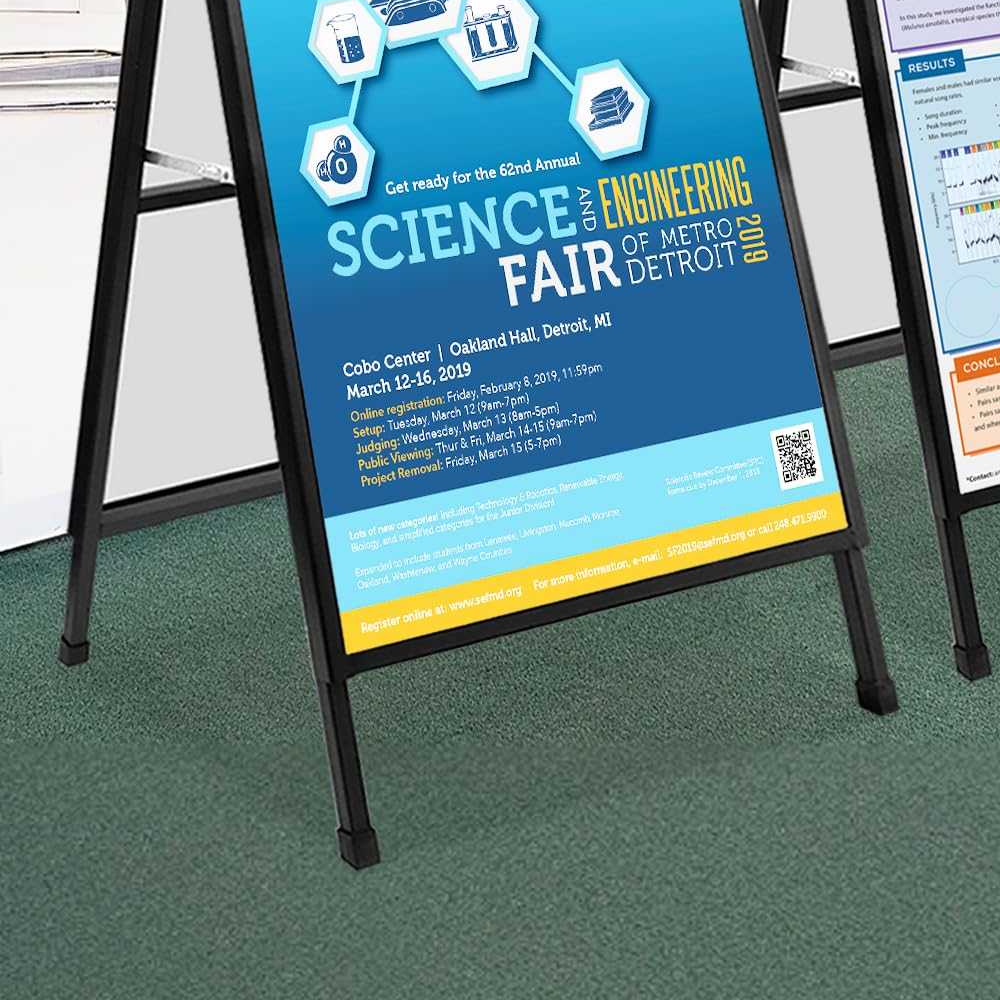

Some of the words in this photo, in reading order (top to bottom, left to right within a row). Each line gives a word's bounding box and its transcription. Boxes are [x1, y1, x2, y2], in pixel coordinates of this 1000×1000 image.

[908, 57, 956, 73] RESULTS
[385, 180, 410, 195] Get
[411, 173, 450, 192] ready
[452, 170, 472, 185] for
[474, 166, 497, 181] the
[499, 159, 533, 177] 62nd
[534, 151, 581, 172] Annual
[327, 185, 578, 277] SCIENCE
[576, 186, 597, 232] AND
[597, 155, 753, 230] ENGINEERING
[735, 213, 769, 264] 2019
[498, 239, 622, 307] FAIR
[621, 231, 649, 256] OF
[660, 217, 733, 249] METRO
[625, 240, 737, 285] DETROIT
[342, 359, 381, 378] Cobo
[383, 350, 431, 370] Center
[449, 332, 508, 357] Oakland
[508, 326, 540, 346] Hall,
[541, 317, 592, 339] Detroit,
[594, 311, 612, 329] MI
[346, 378, 392, 401] March
[394, 369, 436, 391] 12-16,
[438, 361, 472, 382] 2019
[350, 407, 385, 423] Online
[385, 395, 446, 417] registration:
[446, 387, 479, 403] Friday,
[479, 380, 522, 396] February
[523, 375, 533, 388] 8,
[533, 370, 561, 386] 2019,
[561, 363, 603, 379] 11:59pm
[352, 424, 386, 439] Setup:
[386, 414, 431, 431] Tuesday,
[431, 406, 462, 422] March
[463, 403, 476, 416] 12
[477, 392, 530, 415] (9am-7pm)
[357, 454, 390, 472] Public
[389, 447, 434, 464] Viewing:
[434, 441, 459, 454] Thur
[460, 437, 469, 449] &
[469, 434, 486, 447] Fri,
[485, 426, 517, 444] March
[518, 420, 545, 437] 14-15
[545, 410, 597, 433] (9am-7pm)
[360, 470, 397, 488] Project
[397, 459, 444, 479] Removal:
[445, 453, 478, 469] Friday,
[478, 445, 509, 462] March
[510, 441, 524, 454] 15
[523, 433, 562, 454] (5-7pm)
[360, 616, 401, 633] Register
[402, 608, 433, 623] online
[434, 603, 448, 615] at:
[532, 579, 549, 591] For
[549, 573, 575, 587] more
[746, 527, 757, 538] or
[757, 521, 774, 535] call
